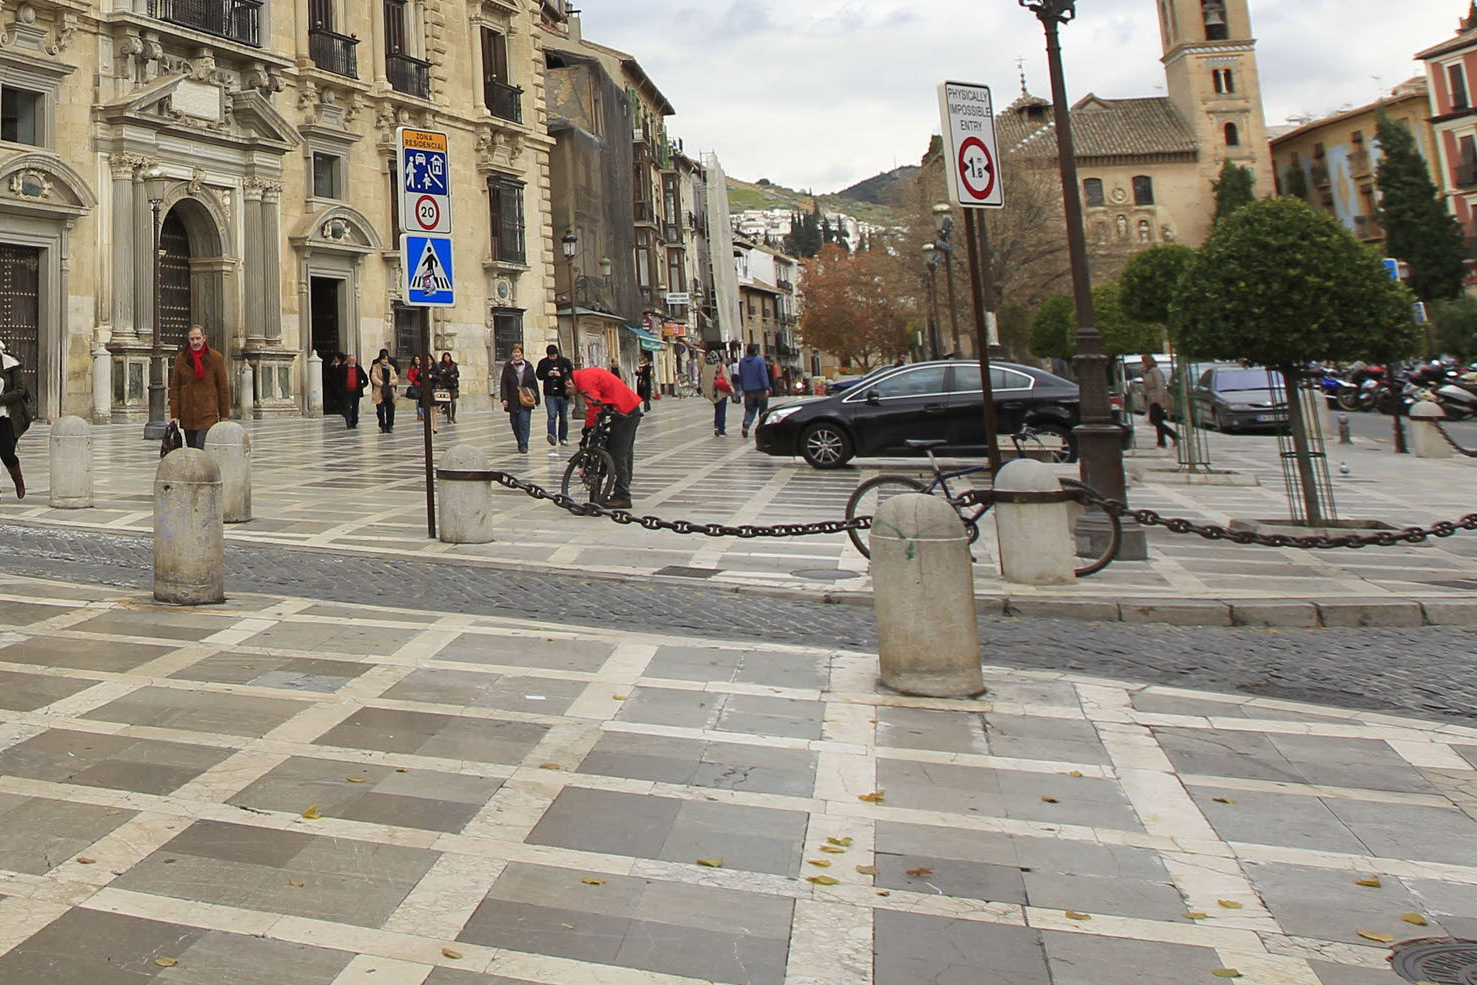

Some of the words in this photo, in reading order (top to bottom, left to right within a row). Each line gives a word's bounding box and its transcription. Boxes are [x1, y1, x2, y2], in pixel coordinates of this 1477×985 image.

[948, 88, 988, 103] PHYSICALLY
[950, 103, 991, 117] IMPOSSIBLE
[960, 120, 983, 132] ENTRY
[416, 133, 433, 141] ZONA
[405, 139, 445, 151] RESIDENCIAL
[420, 206, 435, 218] 20
